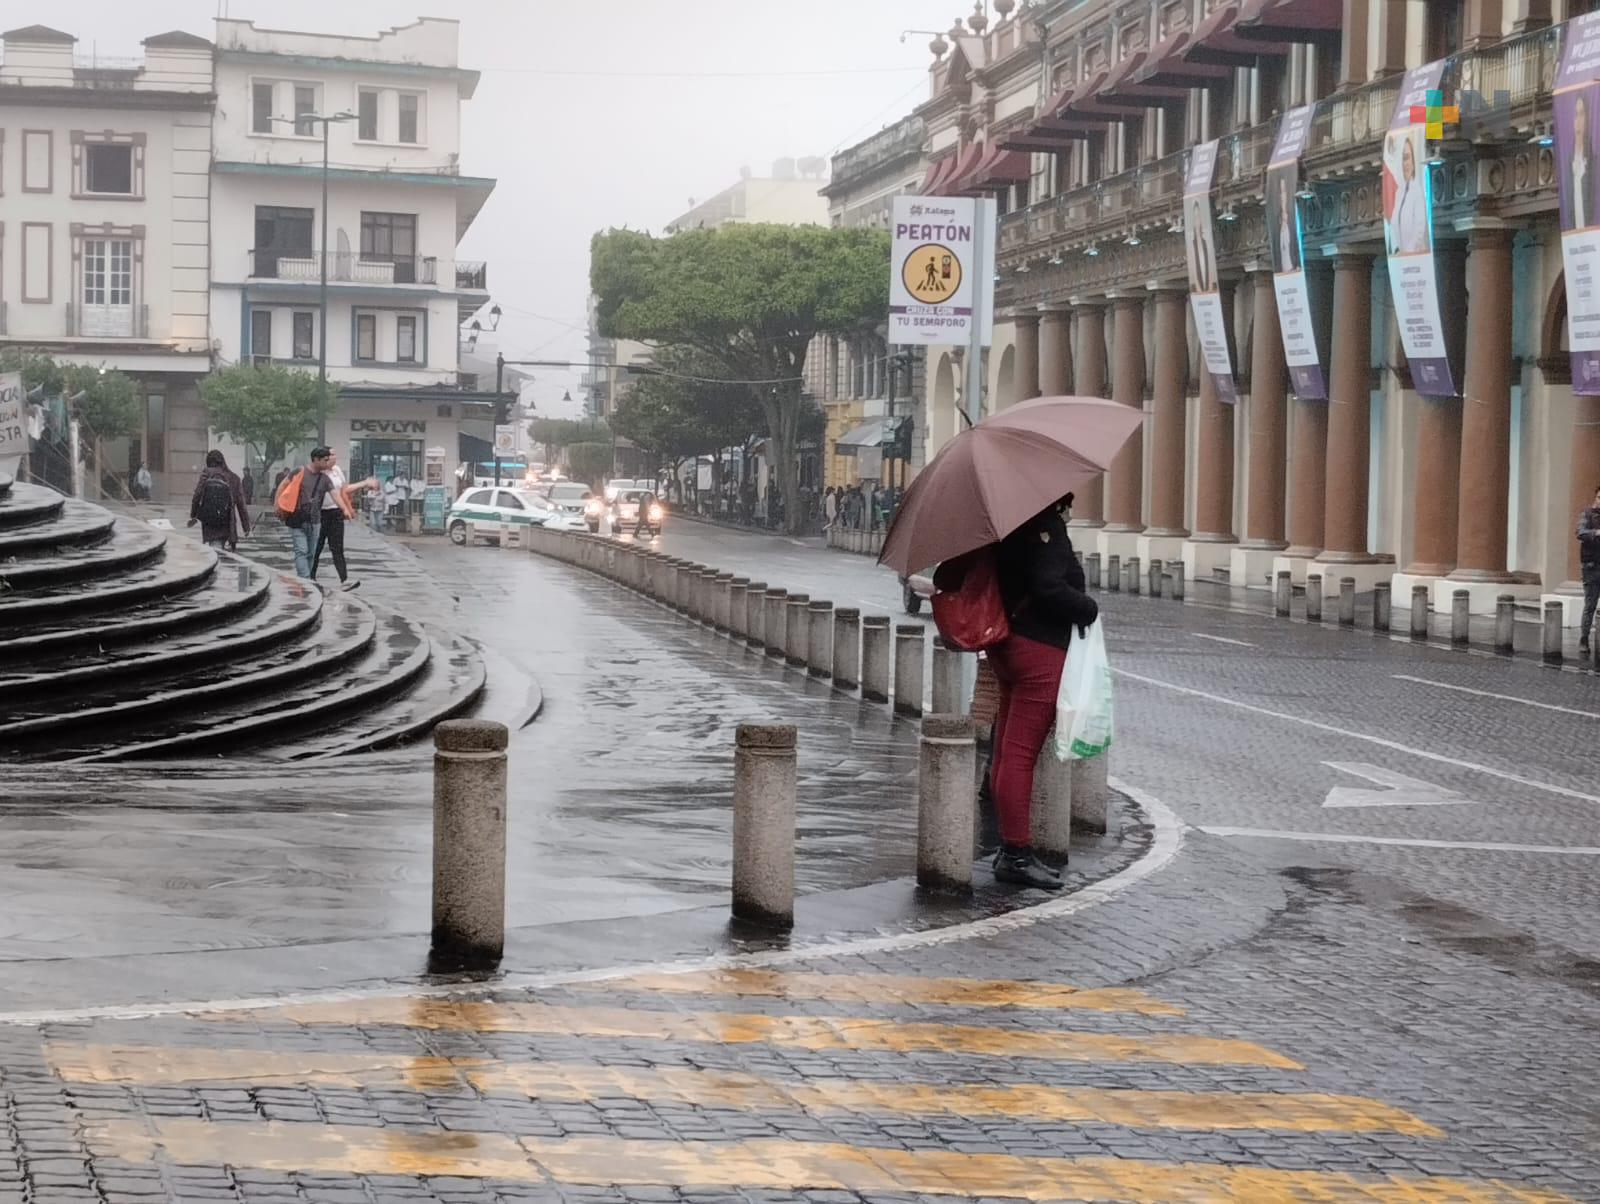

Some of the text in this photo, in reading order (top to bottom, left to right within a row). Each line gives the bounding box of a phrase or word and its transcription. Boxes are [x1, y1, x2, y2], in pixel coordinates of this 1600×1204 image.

[896, 219, 971, 242] PEATÓN
[896, 317, 910, 326] TU
[351, 419, 427, 433] DEVLYN
